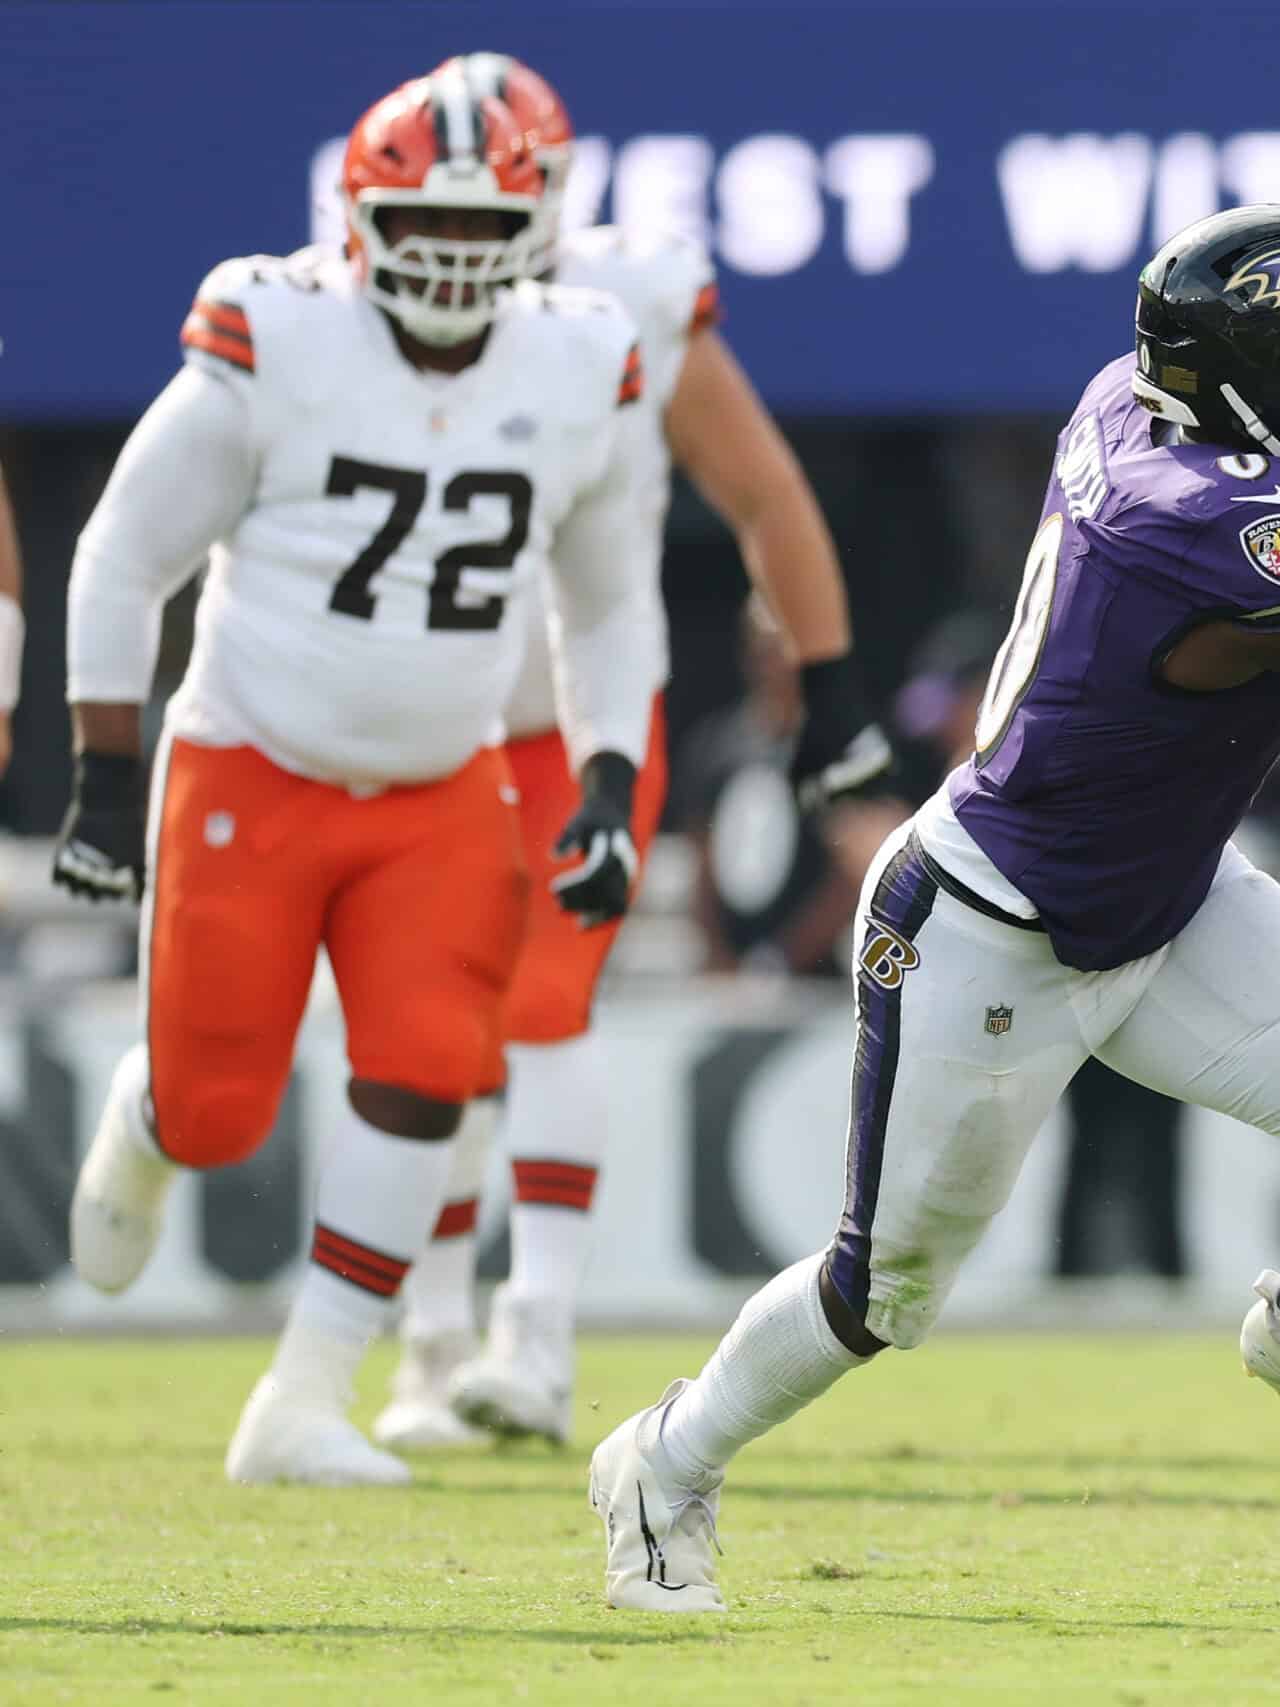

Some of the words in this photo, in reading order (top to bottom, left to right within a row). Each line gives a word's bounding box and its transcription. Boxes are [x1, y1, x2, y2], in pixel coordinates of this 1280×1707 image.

[308, 132, 934, 275] EST
[325, 453, 533, 631] 72
[990, 1018, 1009, 1035] NFL
